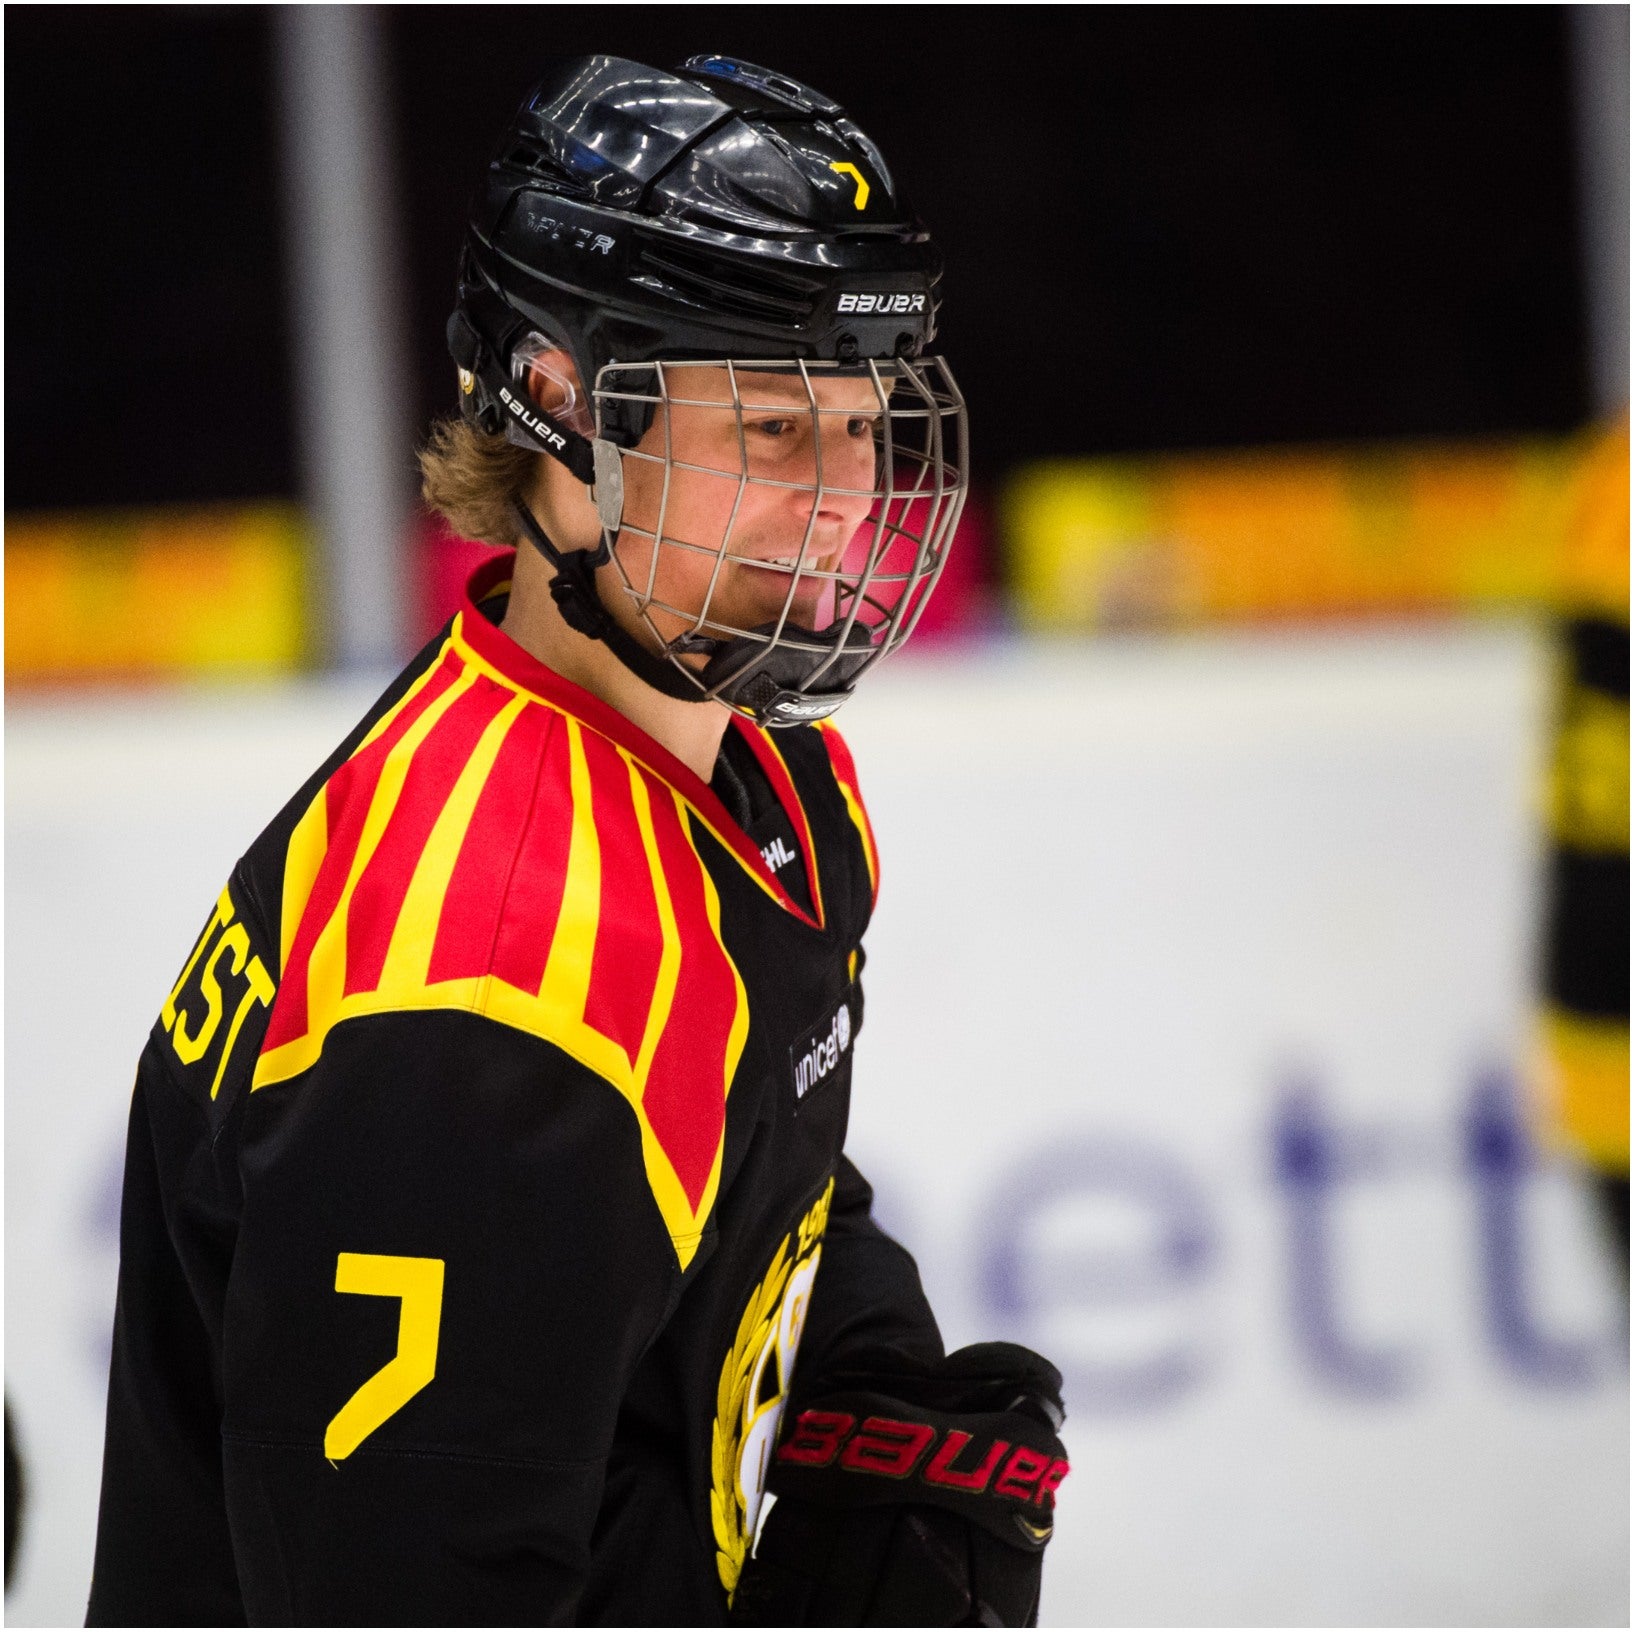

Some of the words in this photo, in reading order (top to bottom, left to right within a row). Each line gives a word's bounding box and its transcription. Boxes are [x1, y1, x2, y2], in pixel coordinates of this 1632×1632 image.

[829, 162, 871, 211] 7
[837, 293, 926, 313] BAUER
[500, 387, 566, 450] BAUER
[760, 837, 796, 873] HL
[795, 1015, 839, 1099] unicef
[324, 1252, 446, 1461] 7
[777, 1410, 1072, 1511] BAUER
